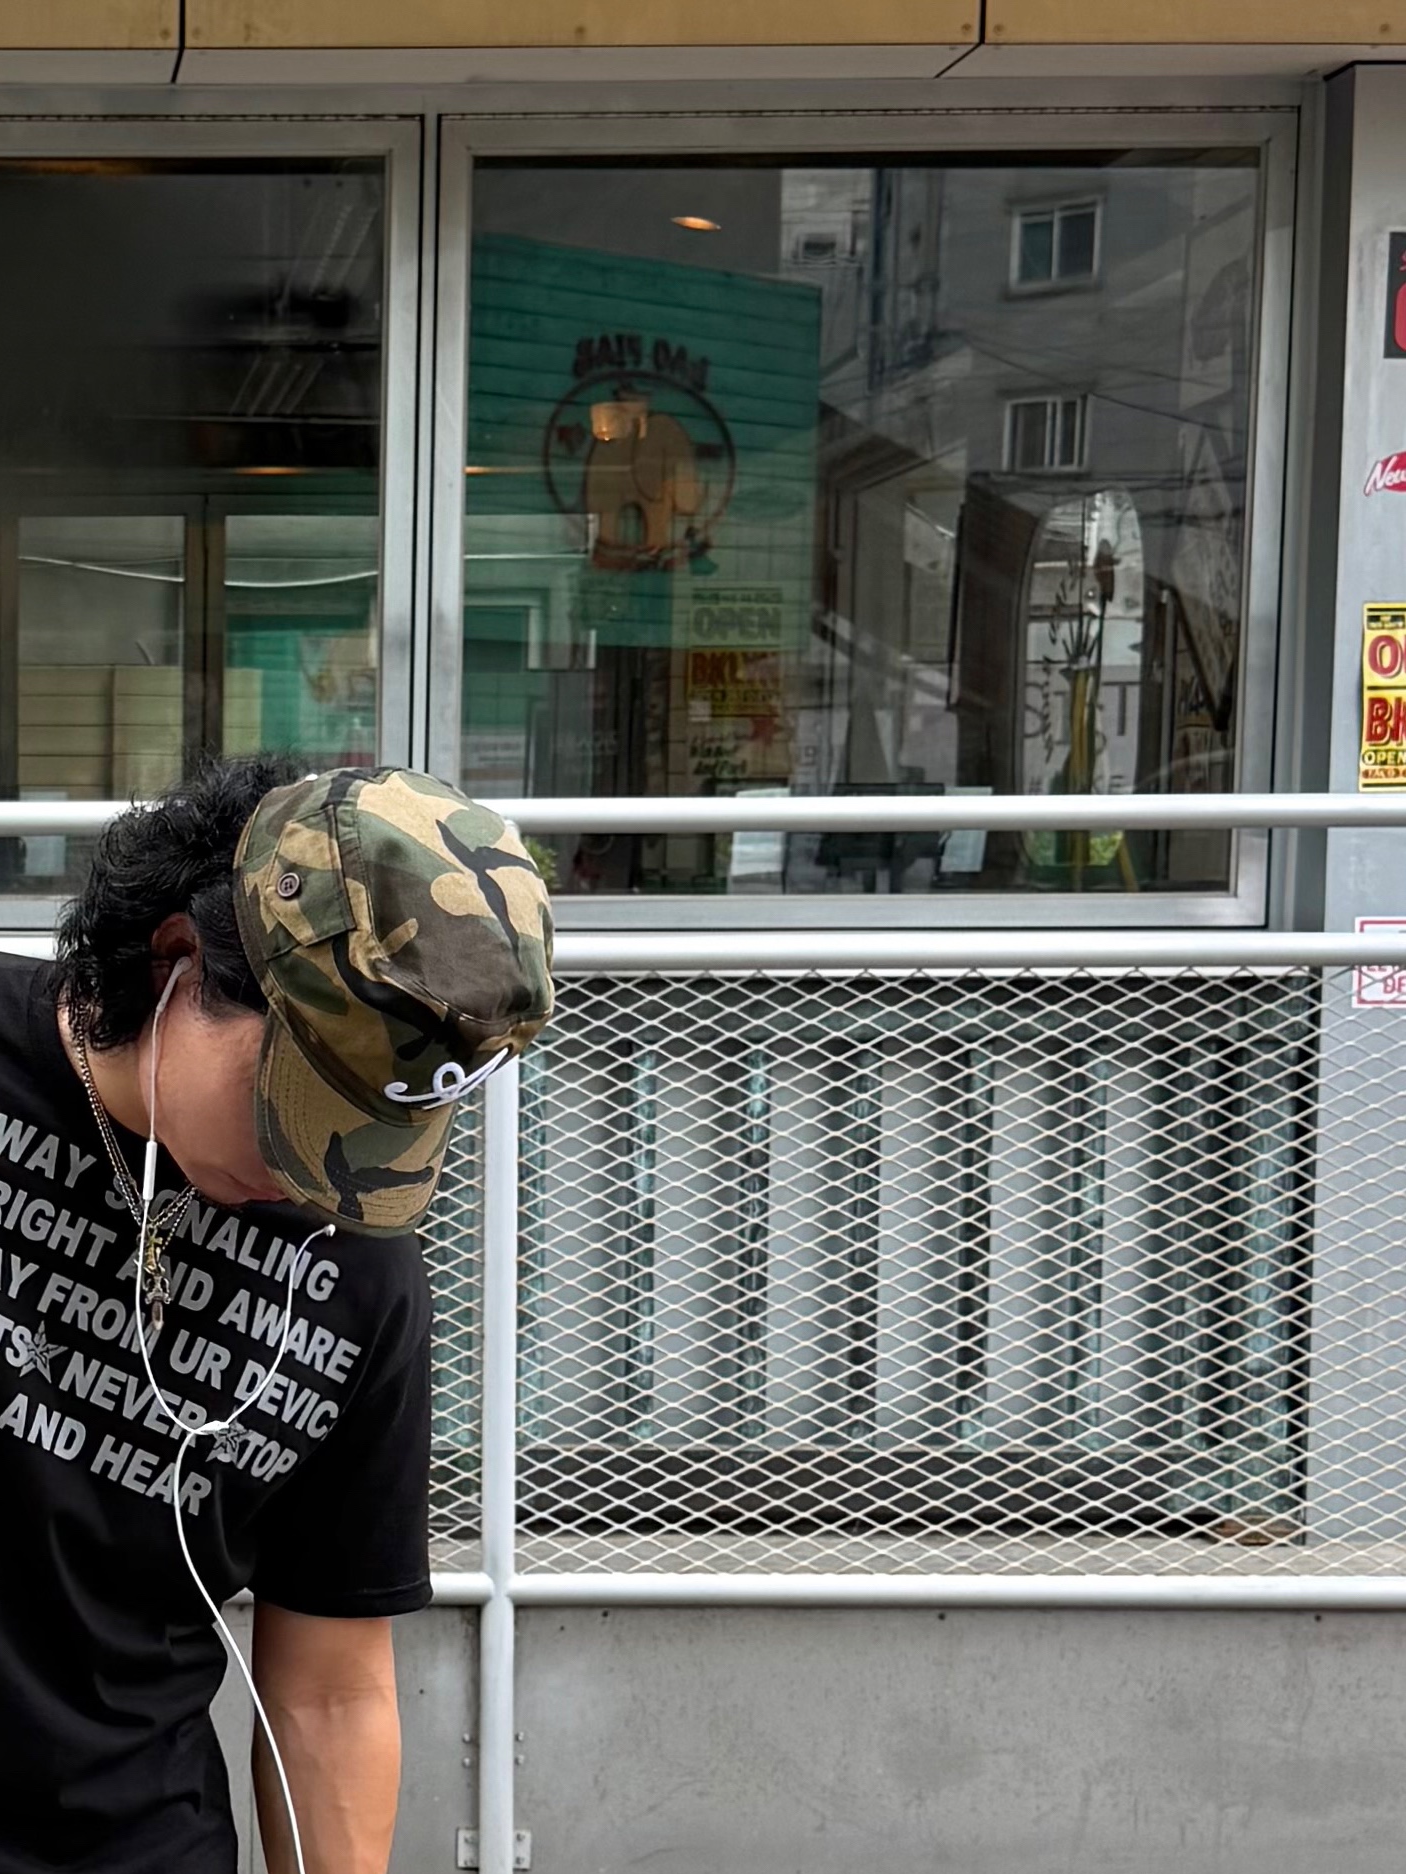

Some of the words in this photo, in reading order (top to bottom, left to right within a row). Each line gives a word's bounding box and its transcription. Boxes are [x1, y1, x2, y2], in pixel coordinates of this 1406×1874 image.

[37, 1273, 162, 1358] FROM
[169, 1329, 231, 1390] UR
[218, 1289, 362, 1384] AWARE
[59, 1351, 208, 1448] NEVER
[90, 1434, 212, 1516] HEAR
